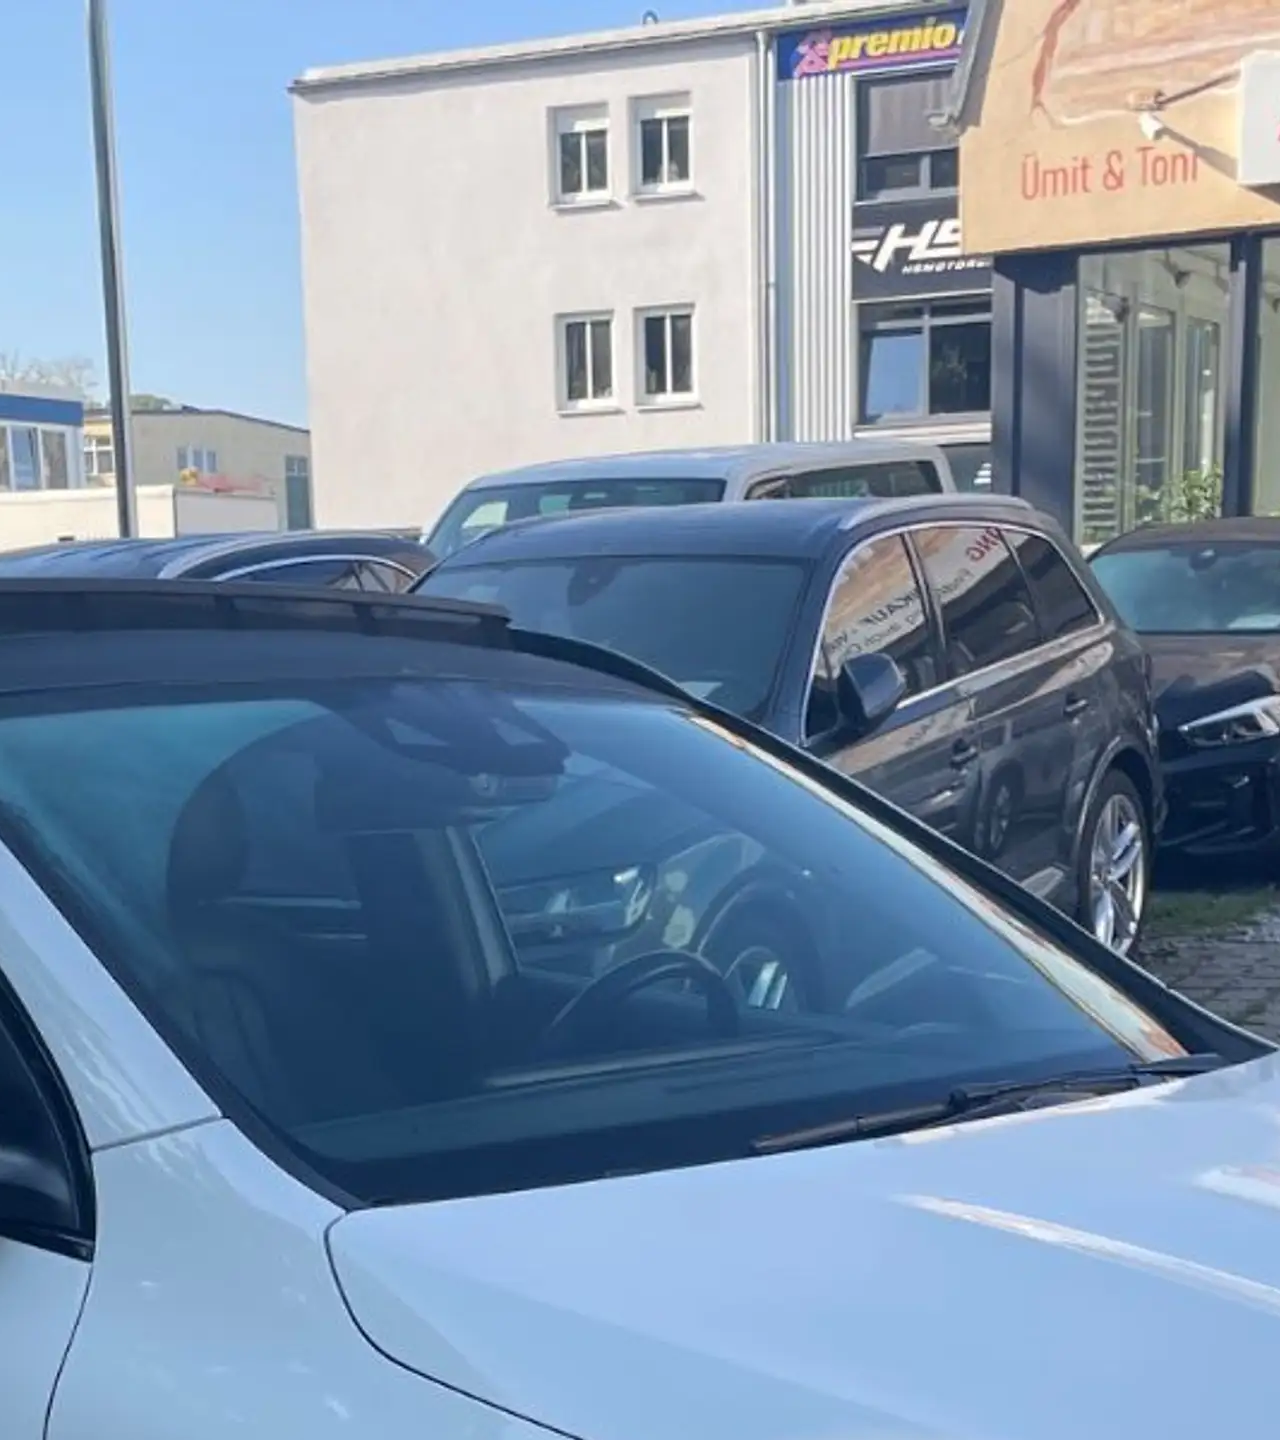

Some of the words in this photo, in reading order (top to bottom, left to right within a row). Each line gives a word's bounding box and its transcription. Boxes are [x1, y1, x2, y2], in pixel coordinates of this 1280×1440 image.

[828, 16, 957, 70] premio
[1022, 152, 1093, 201] Ümit
[1102, 149, 1125, 191] &
[1135, 146, 1199, 187] Toni
